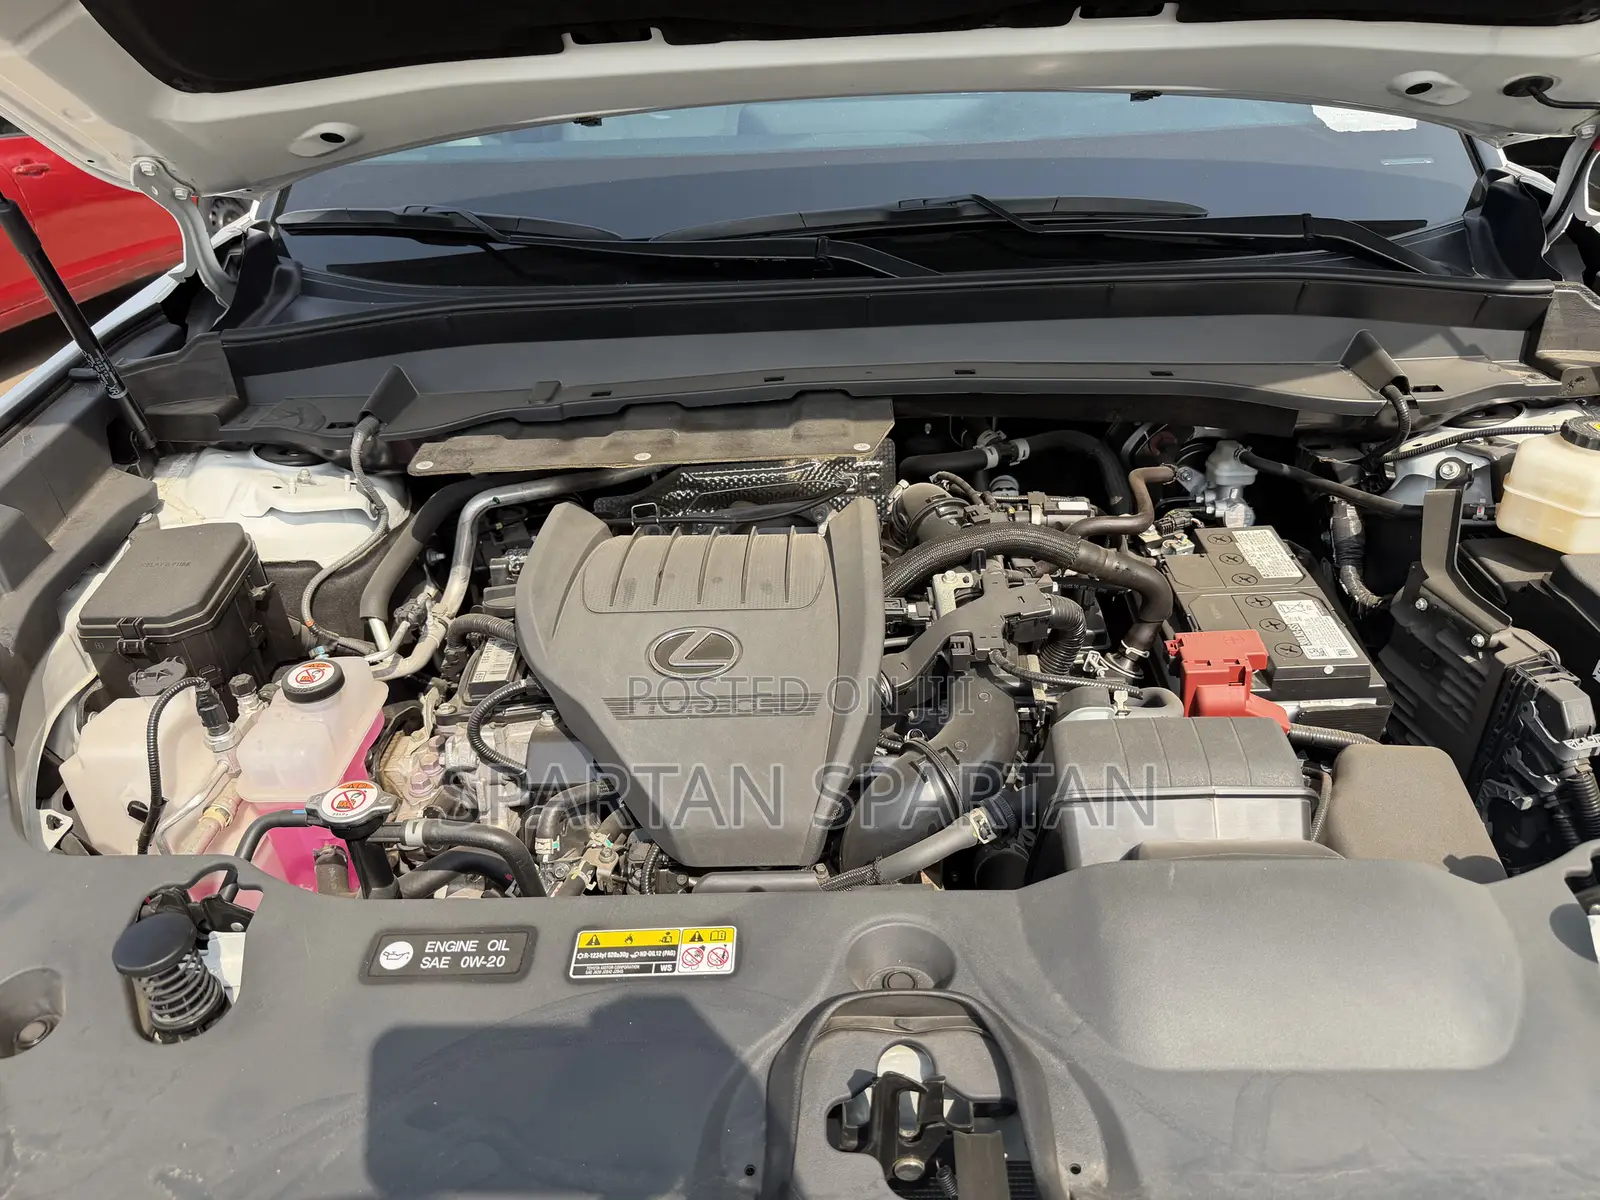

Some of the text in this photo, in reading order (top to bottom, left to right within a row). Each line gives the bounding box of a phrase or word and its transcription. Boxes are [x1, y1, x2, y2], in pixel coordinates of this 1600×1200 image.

[424, 939, 510, 953] ENGINE OIL
[420, 955, 506, 969] SAE 0W-20
[660, 964, 673, 972] WS
